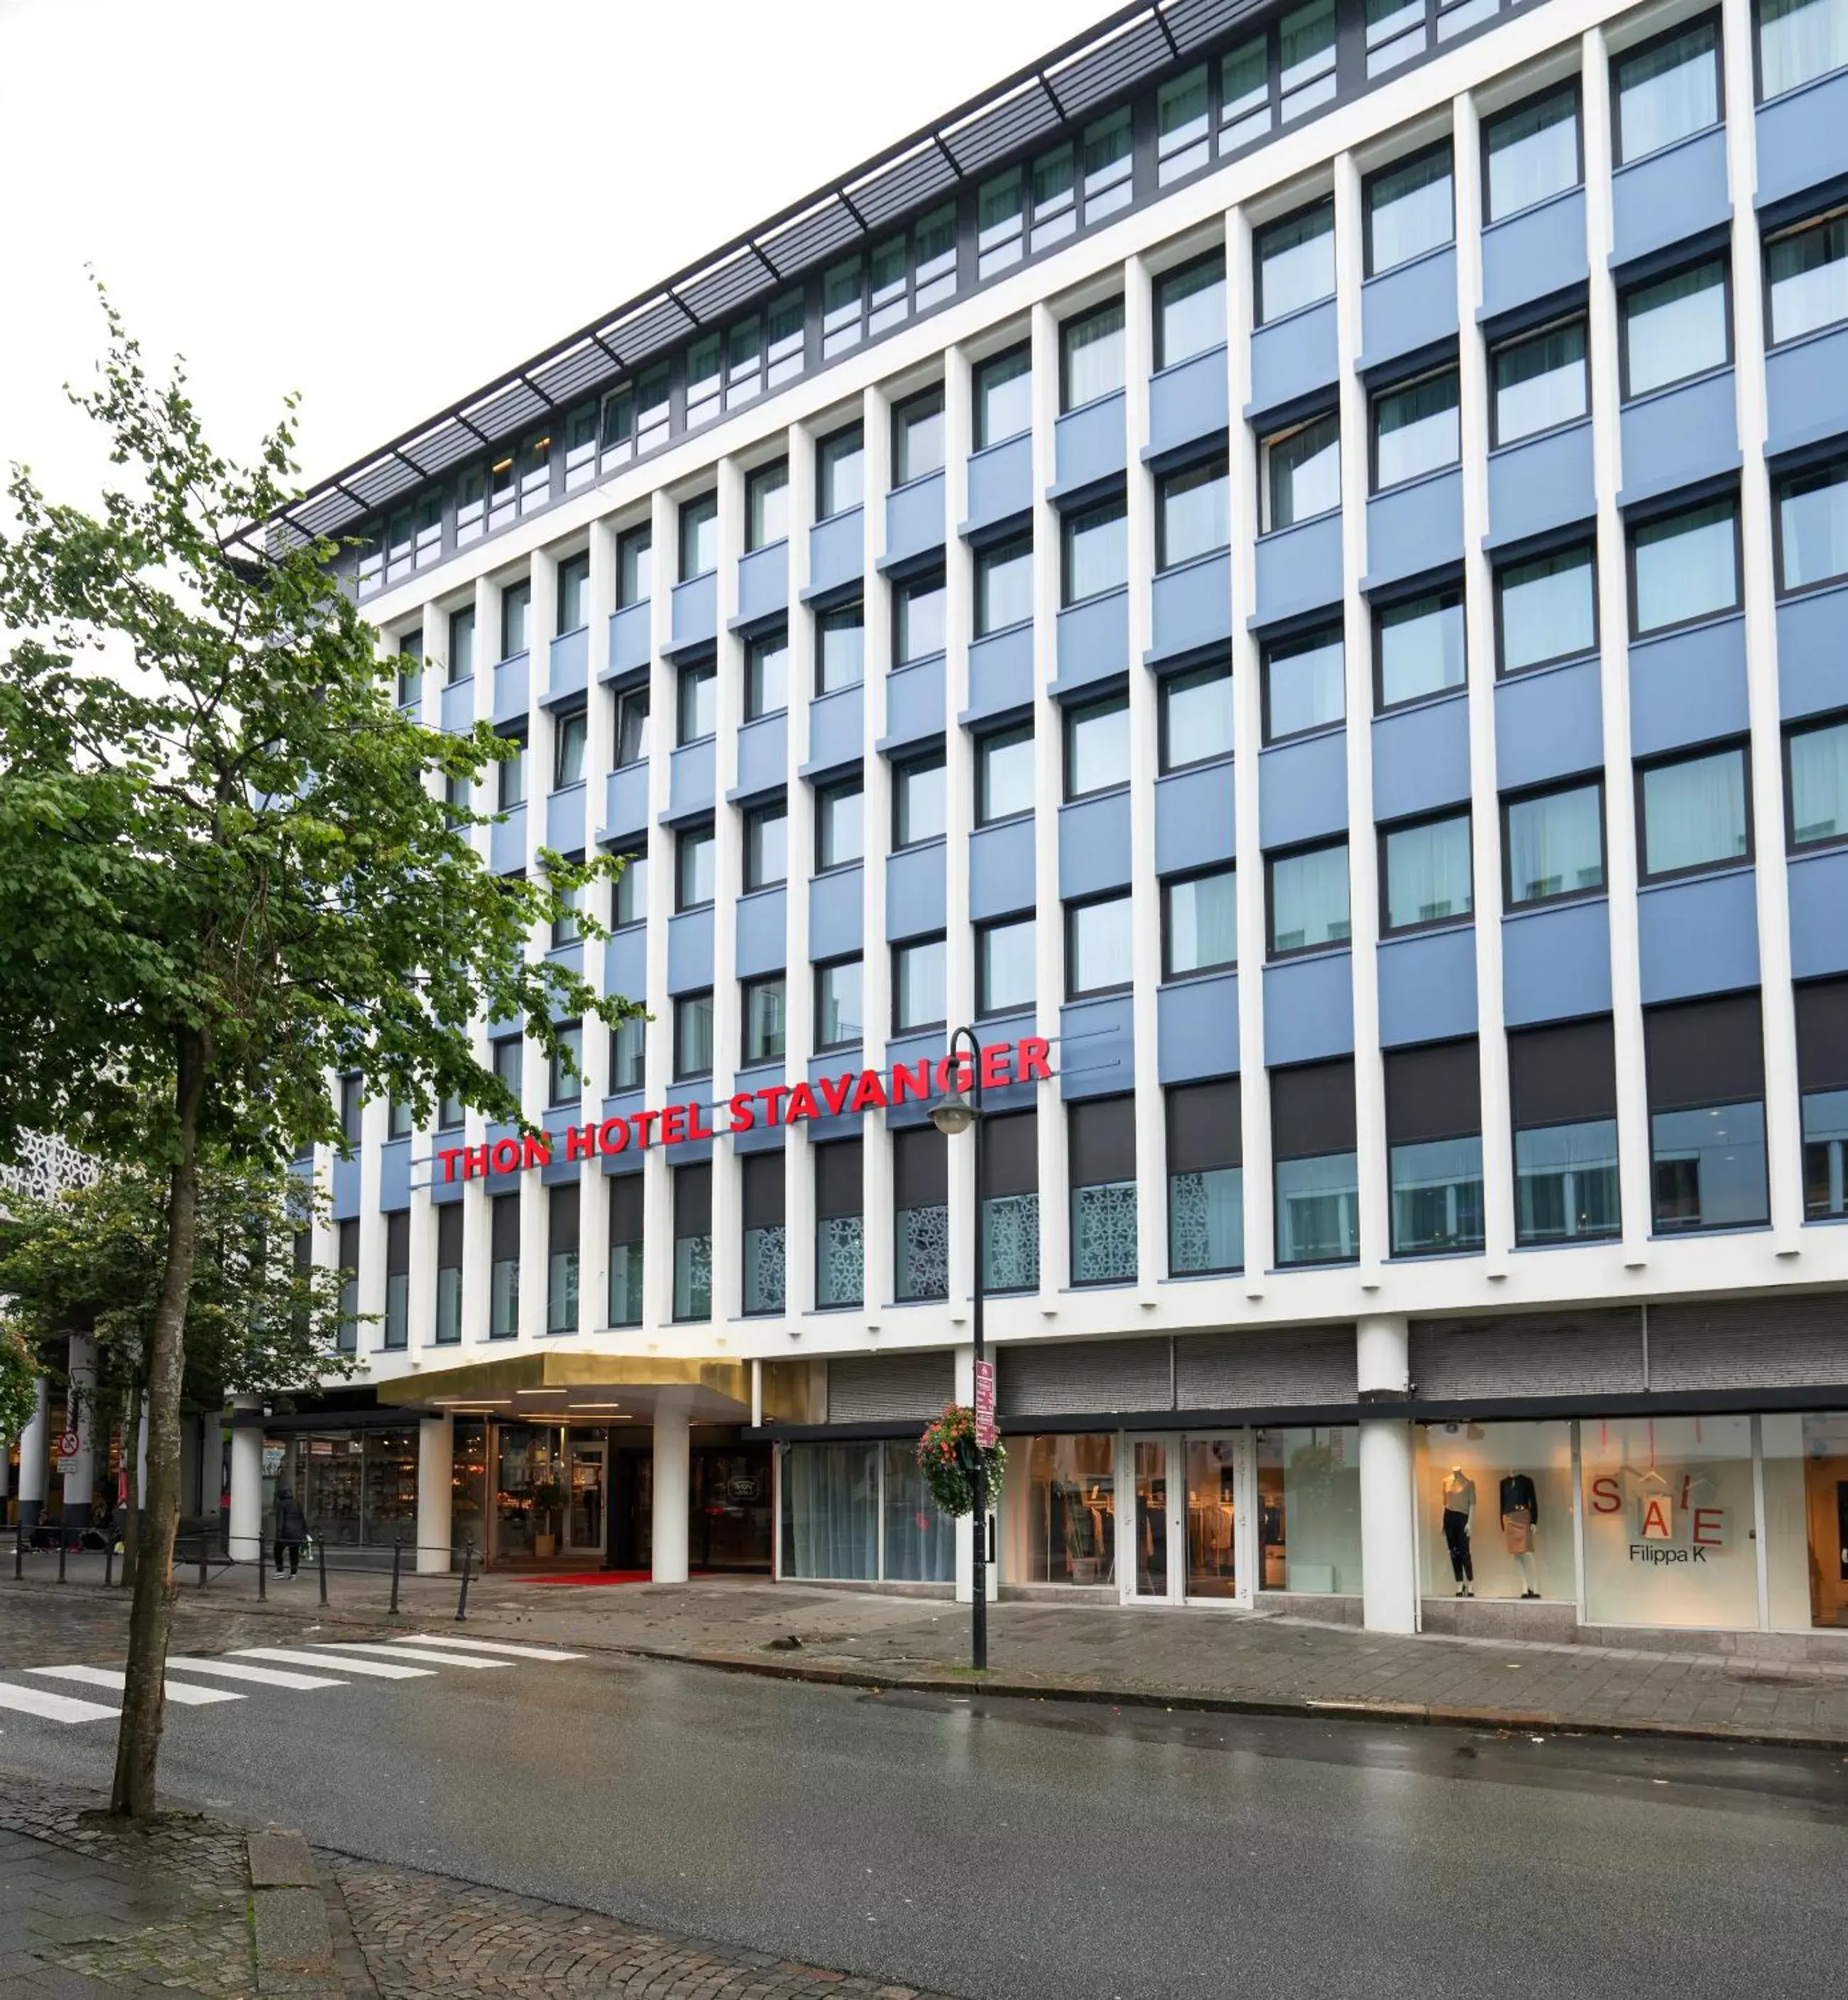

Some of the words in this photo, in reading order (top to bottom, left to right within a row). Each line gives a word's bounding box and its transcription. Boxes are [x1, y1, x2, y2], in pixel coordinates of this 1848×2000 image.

[437, 1130, 553, 1184] THON
[565, 1102, 713, 1162] HOTEL
[729, 1037, 1054, 1134] STAVANGER
[1629, 1545, 1688, 1565] Filippa
[1693, 1546, 1707, 1563] K
